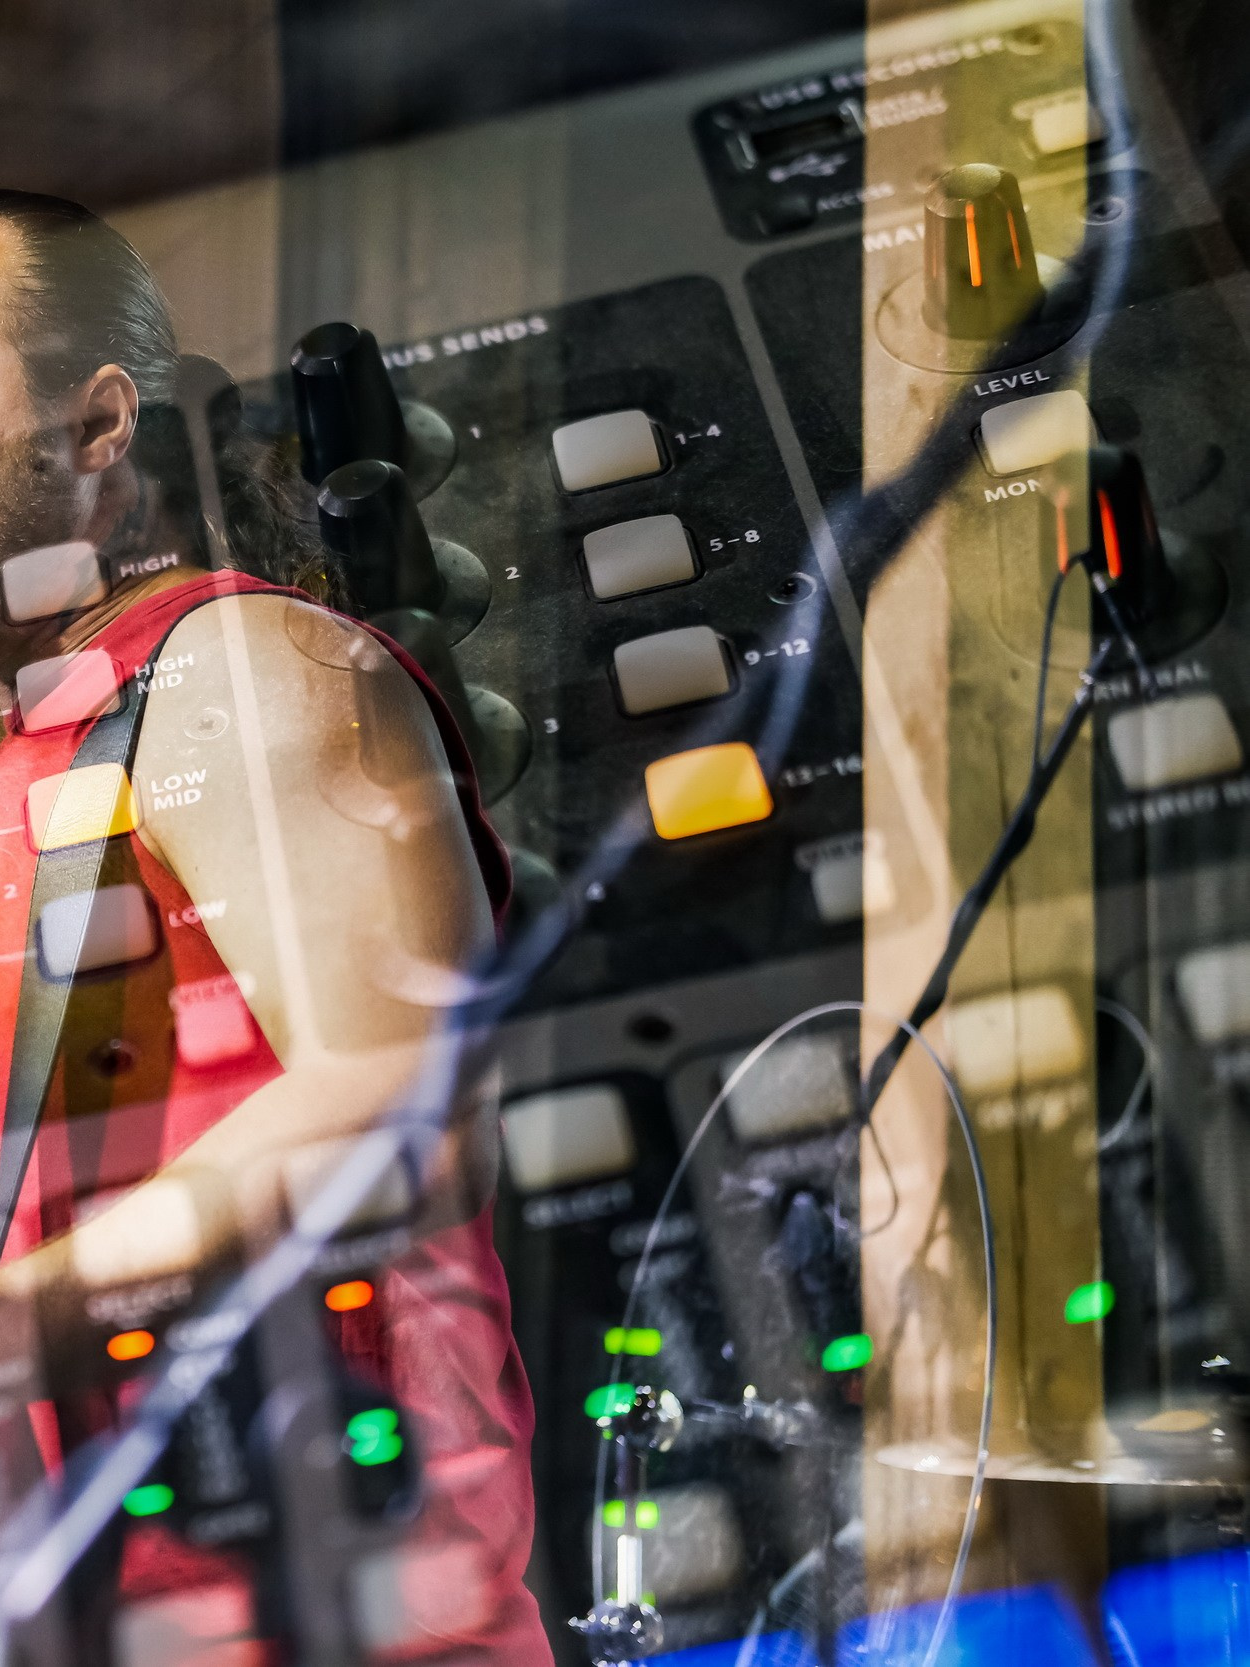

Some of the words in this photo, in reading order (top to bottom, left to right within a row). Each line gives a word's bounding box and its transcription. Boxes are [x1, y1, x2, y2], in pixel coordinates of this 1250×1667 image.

[441, 314, 549, 356] SENDS
[974, 369, 1050, 397] LEVEL
[469, 423, 483, 439] 1
[984, 478, 1044, 503] MON
[119, 552, 180, 578] HIGH
[505, 566, 520, 581] 2
[134, 652, 196, 680] HIGH
[136, 673, 184, 696] MID
[544, 718, 560, 735] 3
[150, 768, 208, 795] LOW
[153, 788, 203, 813] MID
[3, 883, 18, 900] 2
[168, 899, 228, 928] LOW
